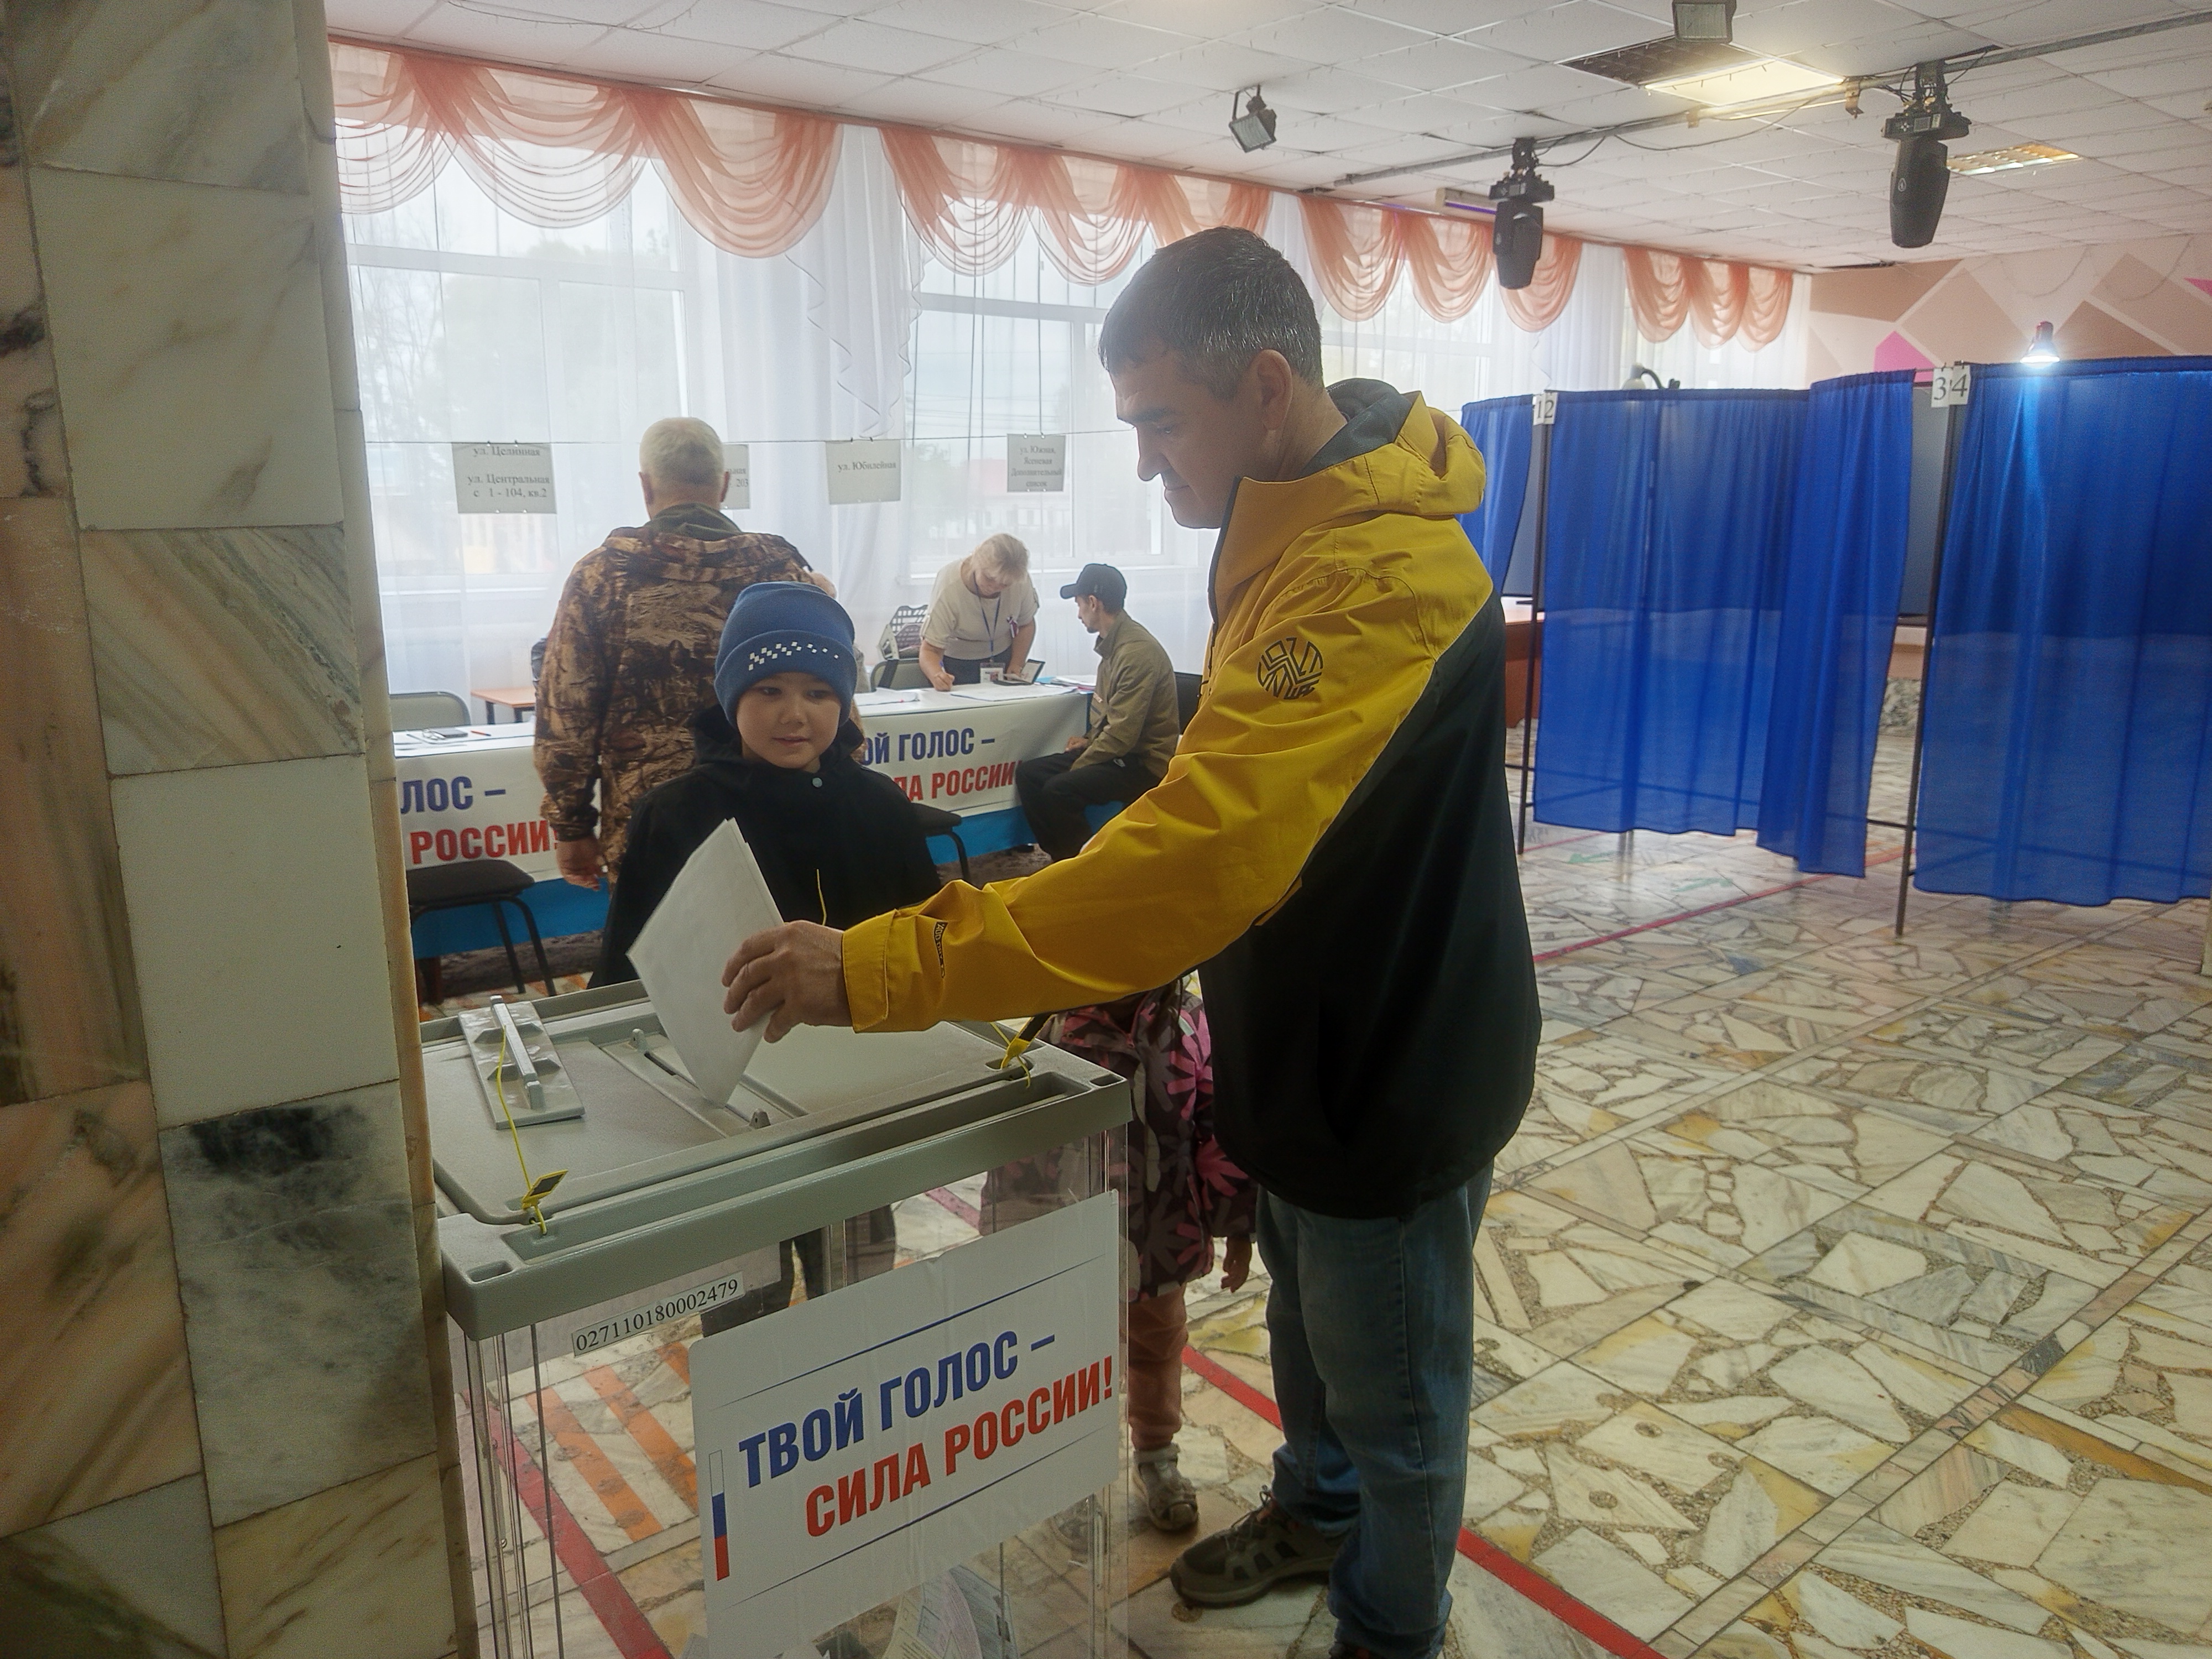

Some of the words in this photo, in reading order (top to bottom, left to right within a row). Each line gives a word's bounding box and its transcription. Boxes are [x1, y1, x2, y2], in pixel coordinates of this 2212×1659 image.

[473, 448, 488, 457] ул.
[492, 446, 540, 456] Целинная
[838, 465, 850, 473] ул.
[852, 461, 896, 470] Юбилейная
[467, 476, 483, 486] ул.
[487, 474, 550, 485] Центральная
[899, 728, 974, 761] ГОЛОС
[576, 1279, 738, 1350] 027110180002479
[739, 1387, 864, 1488] ТВОЙ
[880, 1331, 1018, 1431] ГОЛОС
[806, 1442, 931, 1538] СИЛА
[944, 1355, 1113, 1476] РОССИИ!
